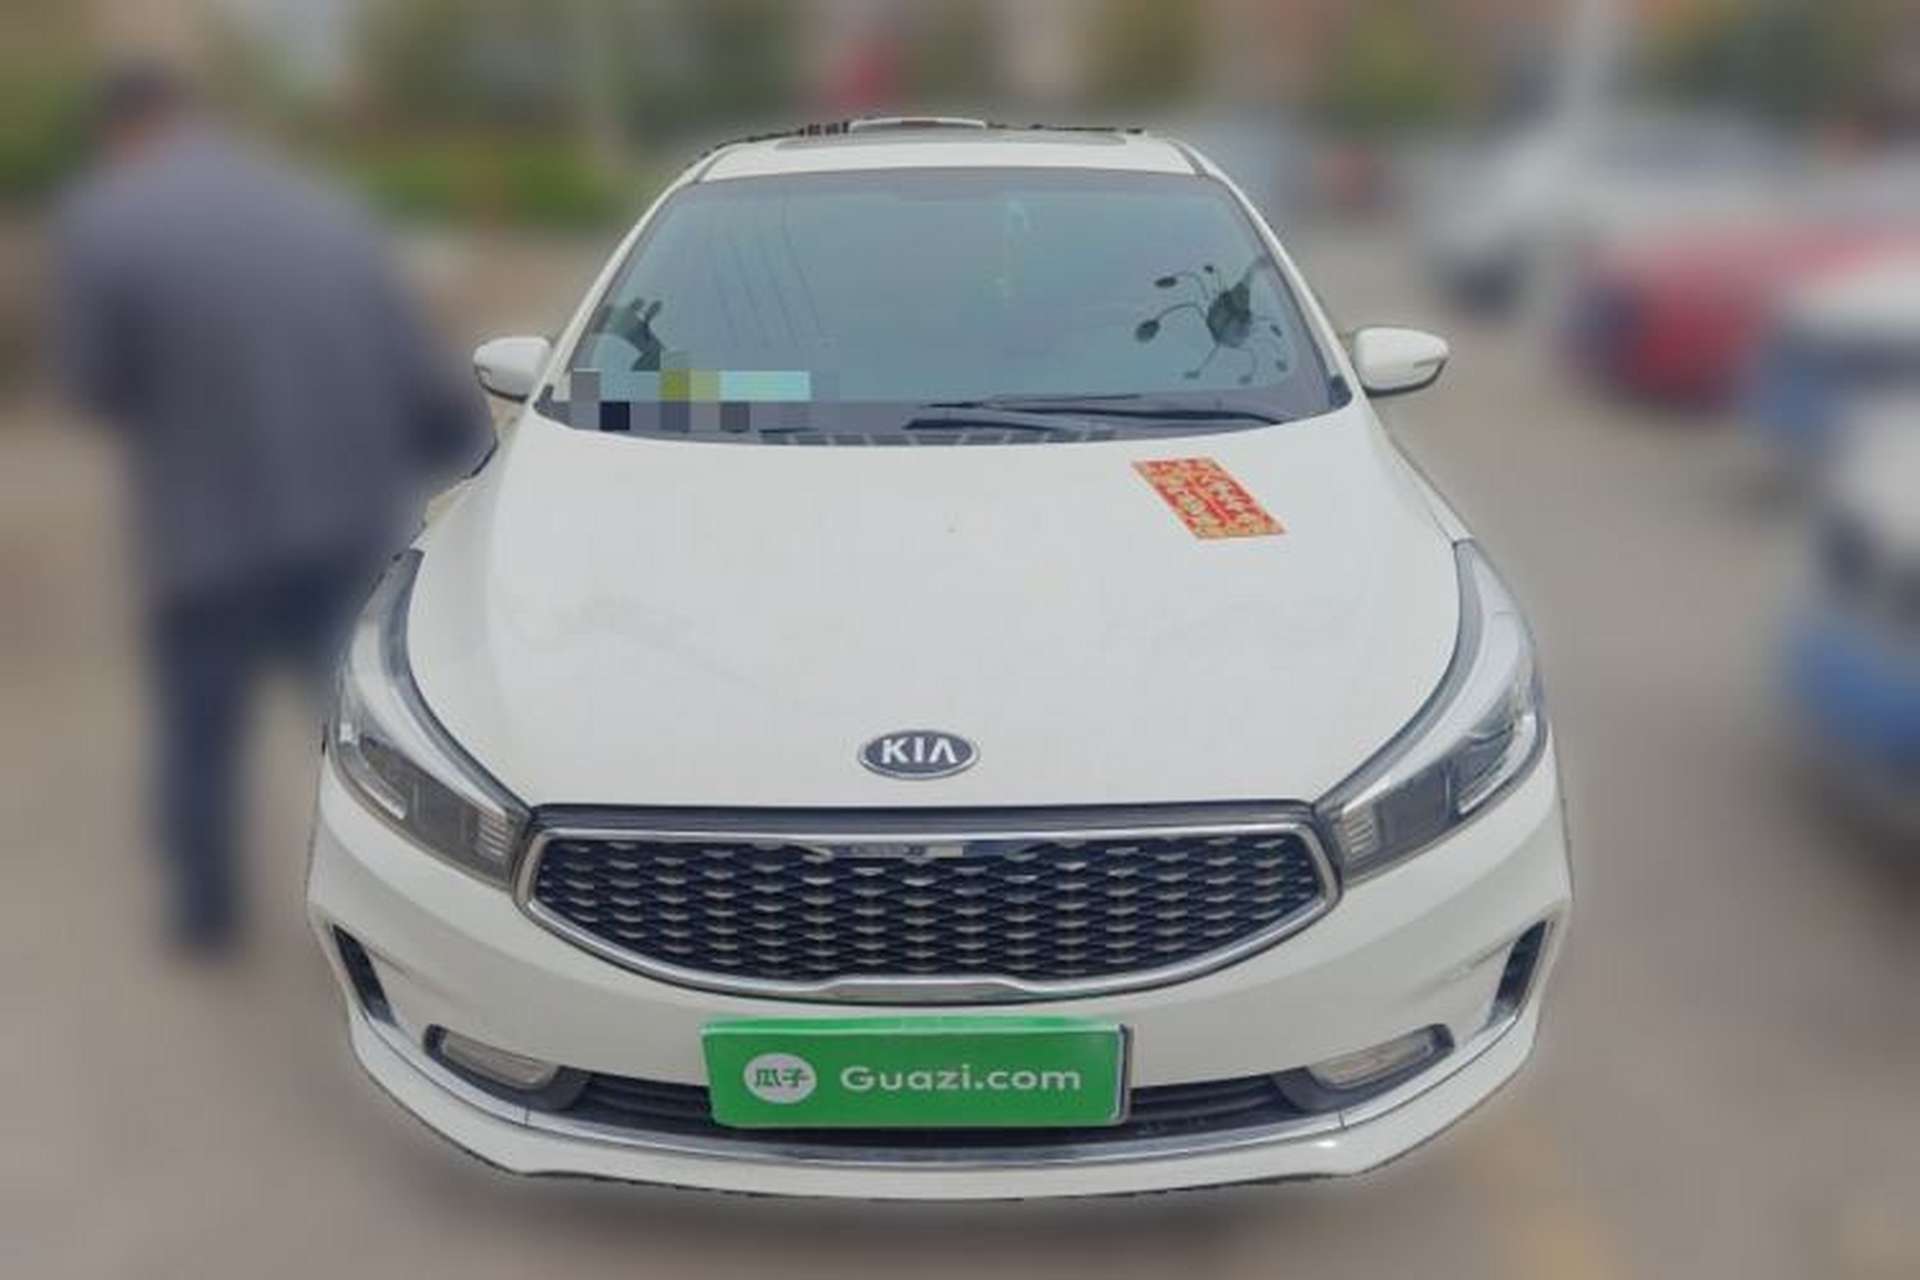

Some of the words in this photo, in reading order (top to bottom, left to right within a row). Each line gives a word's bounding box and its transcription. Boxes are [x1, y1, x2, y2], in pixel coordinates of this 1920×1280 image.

[881, 737, 957, 763] KIA
[754, 1068, 811, 1089] 瓜子
[840, 1064, 1081, 1091] Guazi.com
